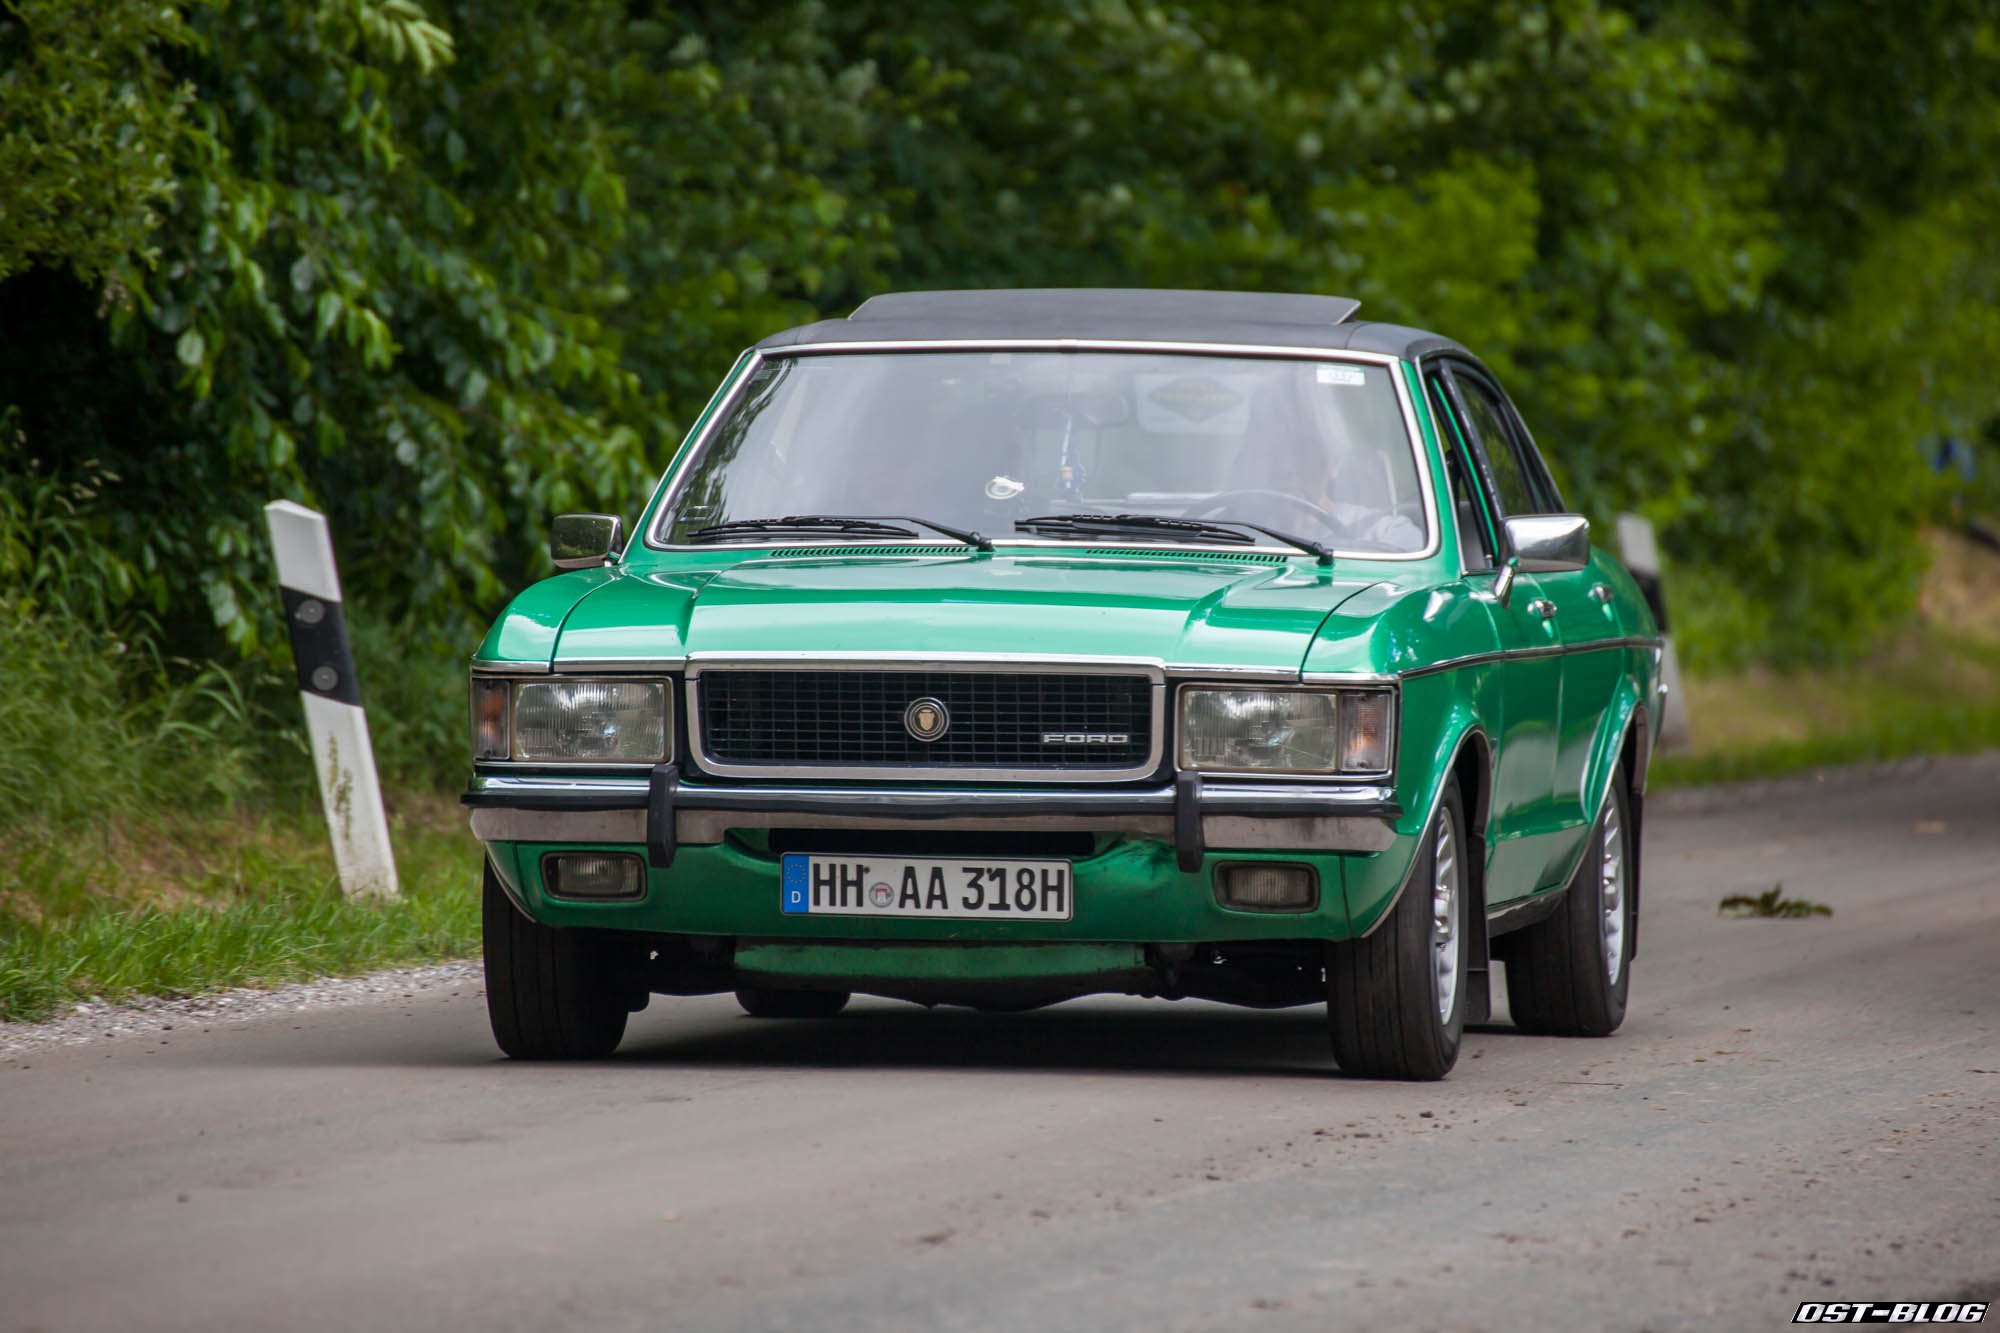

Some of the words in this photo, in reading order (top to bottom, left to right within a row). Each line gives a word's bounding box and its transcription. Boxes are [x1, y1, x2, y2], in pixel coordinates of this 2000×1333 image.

[1043, 734, 1129, 743] FORD
[813, 863, 864, 907] HH
[898, 866, 948, 910] AA
[961, 867, 1065, 912] 318H
[791, 890, 801, 904] D
